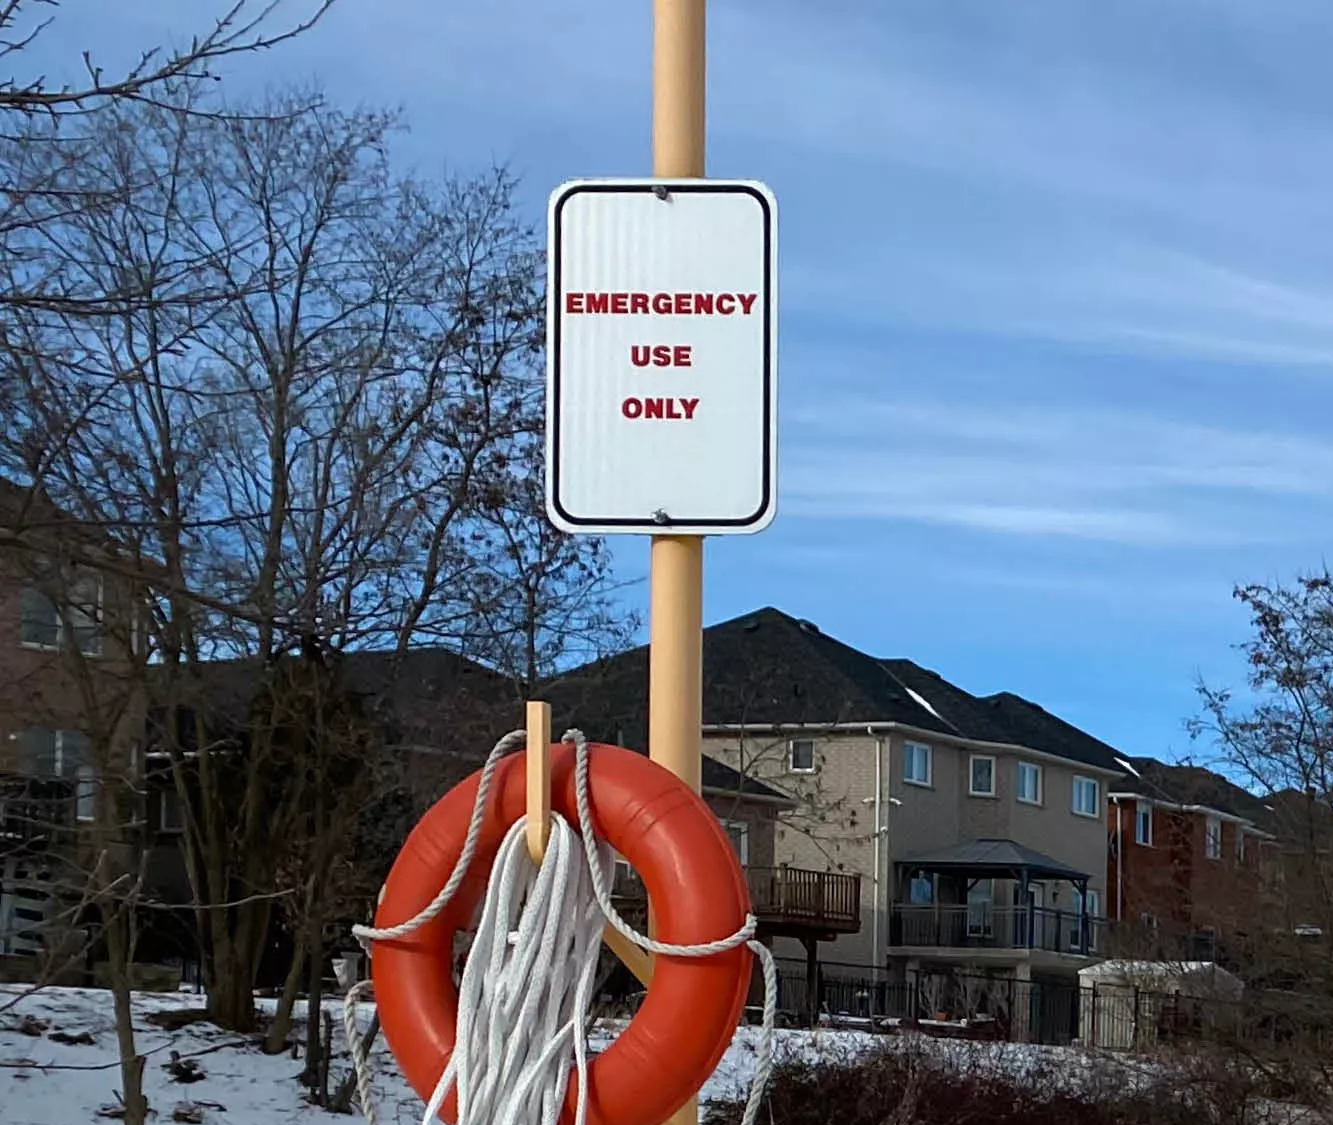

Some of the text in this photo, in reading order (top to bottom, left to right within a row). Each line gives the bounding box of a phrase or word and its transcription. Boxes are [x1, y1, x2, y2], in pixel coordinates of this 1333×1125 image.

[566, 293, 757, 315] EMERGENCY
[631, 346, 692, 367] USE
[621, 397, 700, 420] ONLY
